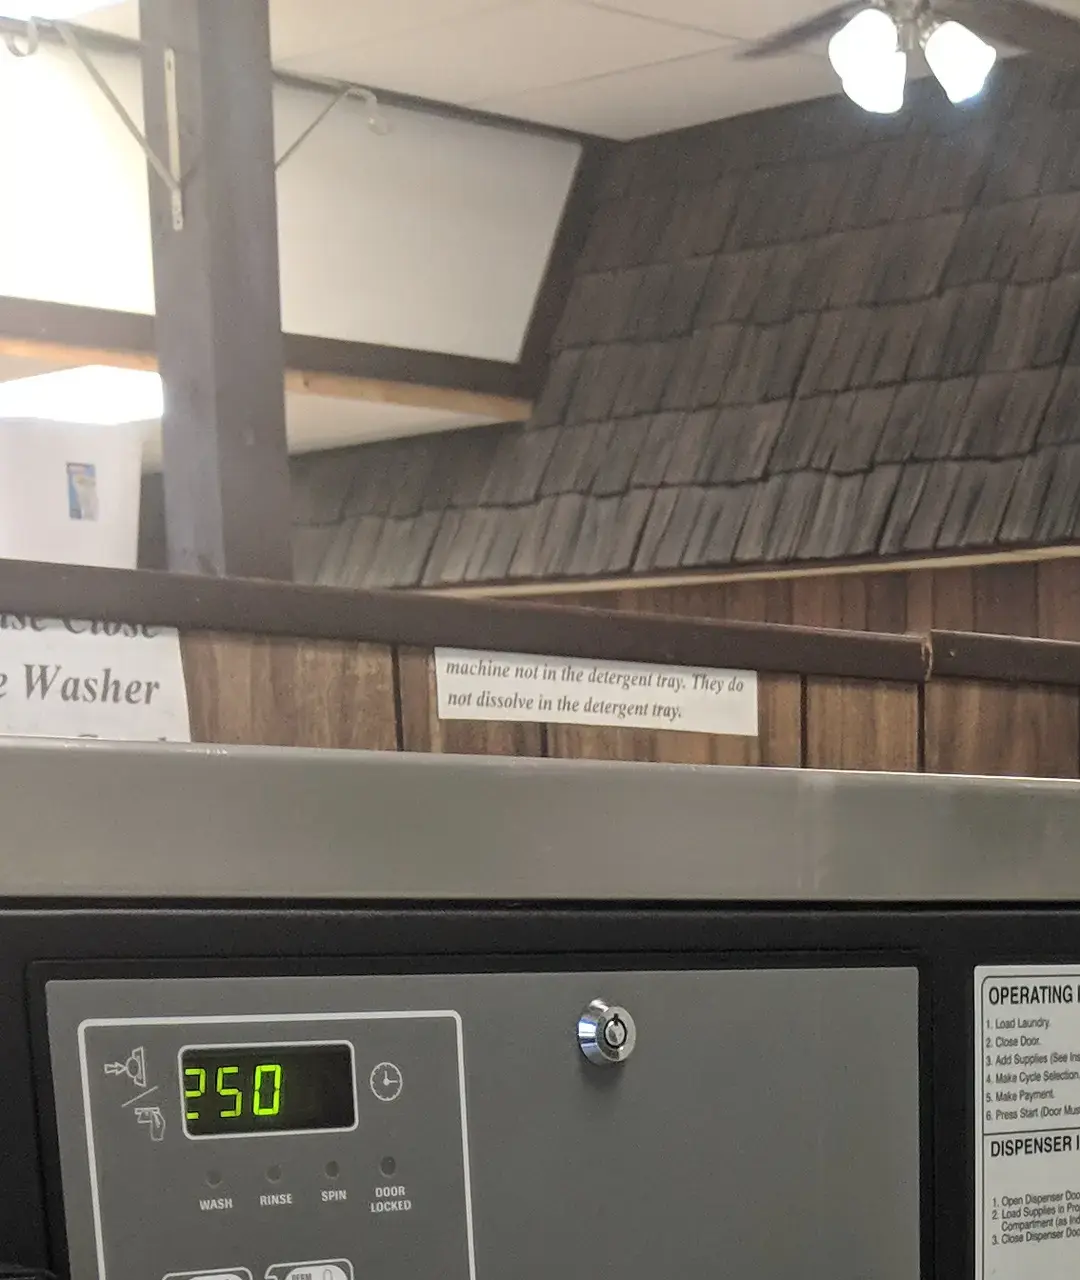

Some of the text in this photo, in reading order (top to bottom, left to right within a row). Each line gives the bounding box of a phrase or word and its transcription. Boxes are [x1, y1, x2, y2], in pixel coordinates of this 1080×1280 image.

[23, 663, 160, 704] Washer
[446, 659, 744, 694] machine not in the detergent tray. They do
[447, 690, 682, 722] not dissolve in the detergent tray.
[988, 984, 1073, 1006] OPERATING
[995, 1018, 1015, 1030] Load
[995, 1036, 1018, 1048] Close
[995, 1054, 1012, 1066] Add
[1014, 1053, 1048, 1067] Supplies
[995, 1072, 1018, 1084] Make
[1019, 1071, 1042, 1084] Cycle
[995, 1091, 1018, 1102] Make
[995, 1109, 1018, 1121] Press
[1019, 1107, 1039, 1119] Start
[990, 1135, 1072, 1158] DISPENSER
[321, 1189, 347, 1202] SPIN
[375, 1186, 406, 1198] DOOR
[200, 1198, 233, 1211] WASH
[259, 1193, 293, 1206] RINSE
[370, 1199, 412, 1213] LOCKED
[1001, 1196, 1023, 1208] Open
[1025, 1192, 1063, 1206] Dispenser
[1001, 1209, 1022, 1220] Load
[1023, 1206, 1056, 1219] Supplies
[1058, 1204, 1065, 1214] in
[1001, 1217, 1054, 1232] Compartment
[1001, 1233, 1024, 1245] Close
[1026, 1230, 1064, 1243] Dispenser
